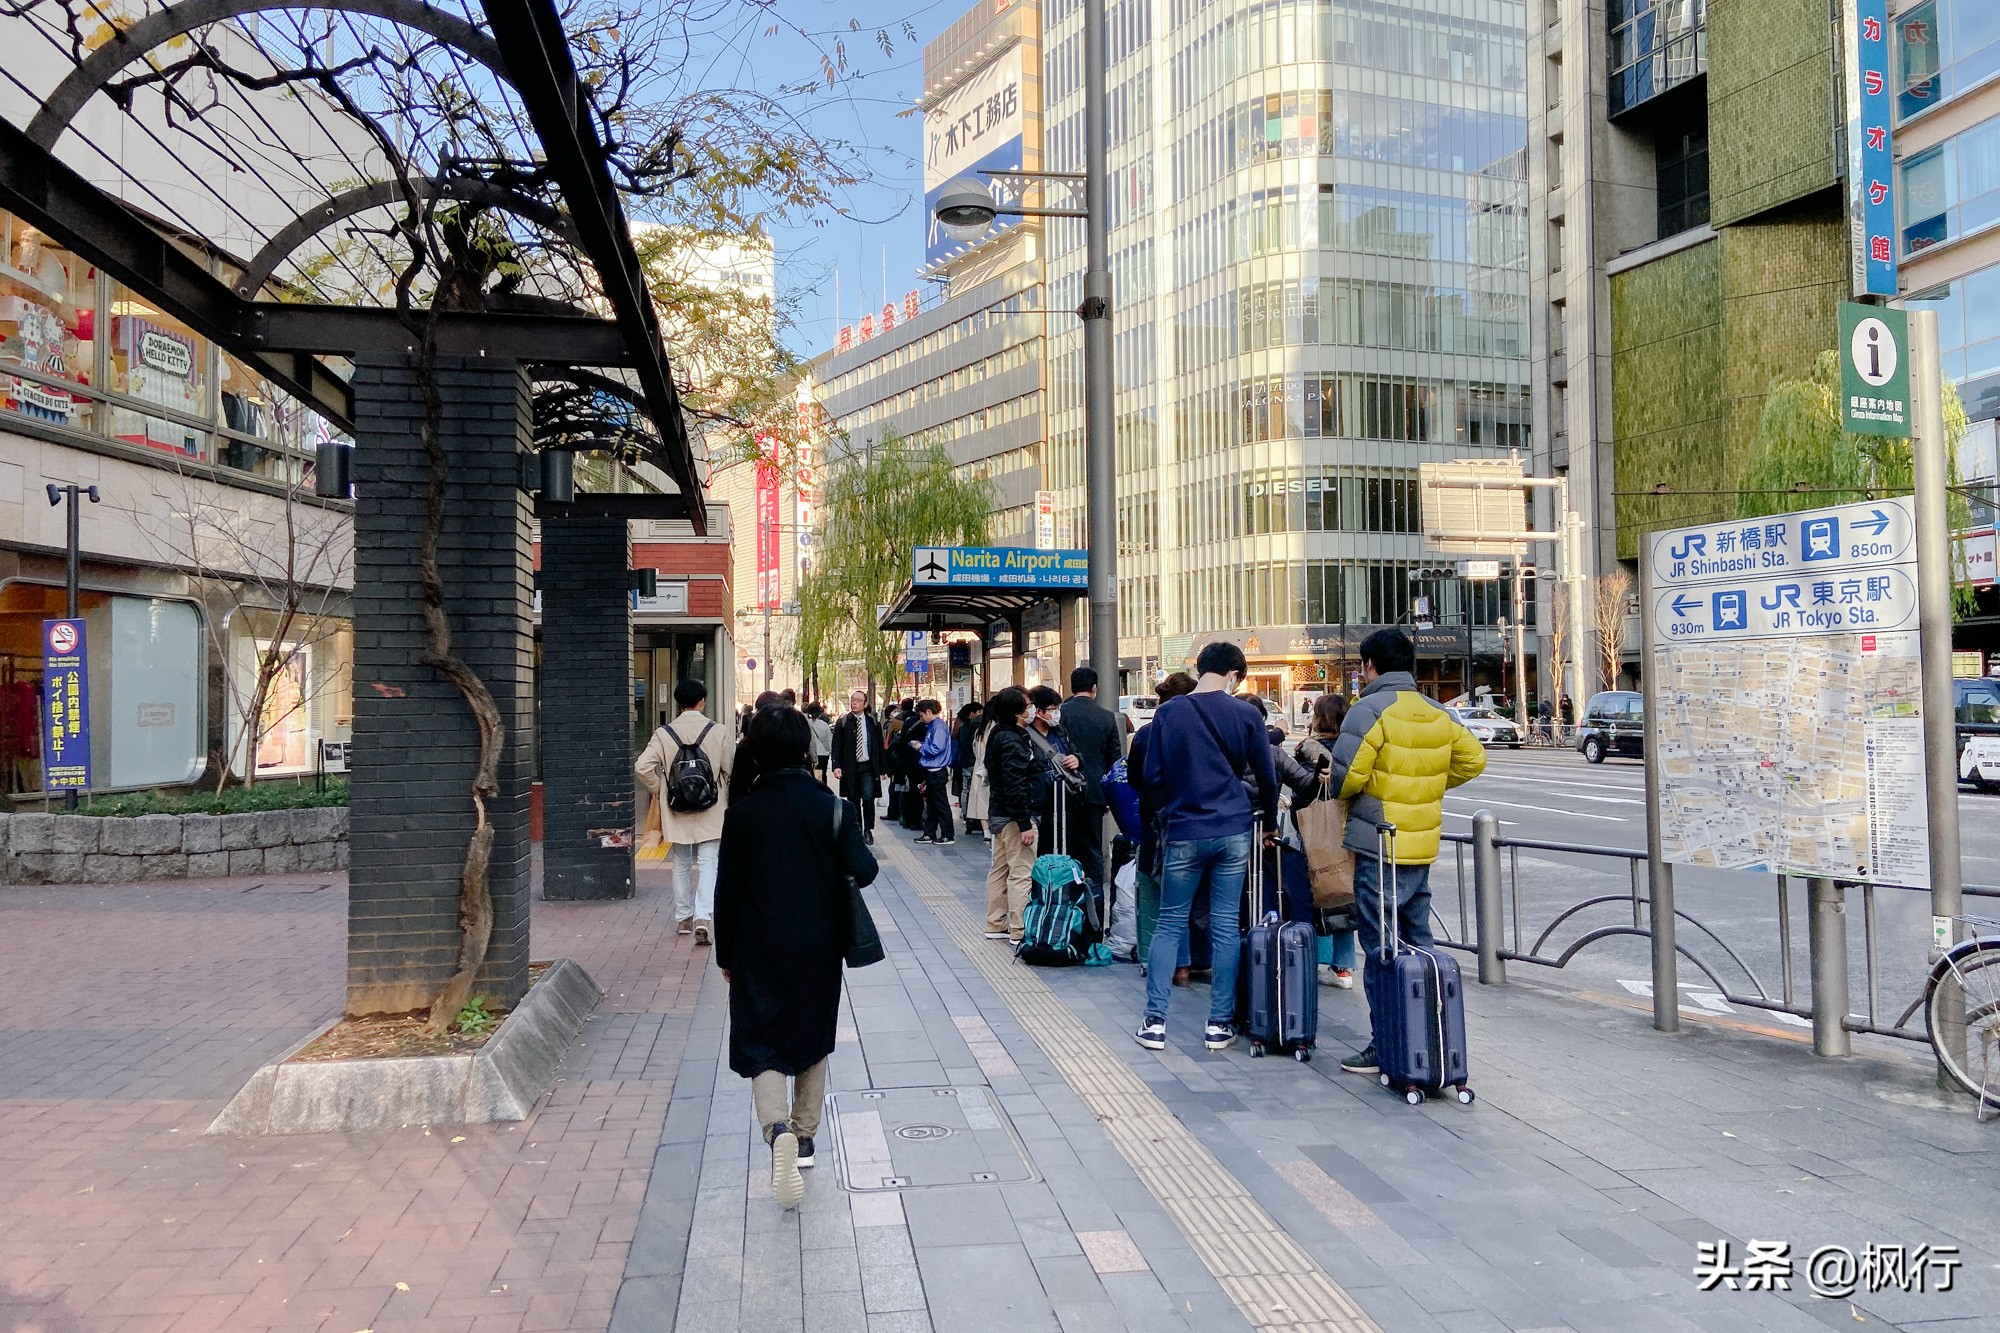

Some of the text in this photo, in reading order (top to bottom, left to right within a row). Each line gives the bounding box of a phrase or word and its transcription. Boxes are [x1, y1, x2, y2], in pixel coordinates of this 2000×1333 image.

[945, 82, 1018, 159] 木下工務店
[1863, 16, 1891, 263] カラオケ館
[148, 337, 186, 358] DORAEMON
[145, 348, 188, 369] HELLO KITTY
[1256, 382, 1303, 394] SHISEDO
[1249, 478, 1337, 497] DIESEL
[1671, 523, 1788, 559] JR 新橋駅
[1851, 542, 1893, 558] 850m
[952, 550, 1061, 573] Narita Airport
[1670, 550, 1790, 578] JR Shinbashi Sta.
[1760, 575, 1893, 611] JR 東京駅
[1671, 622, 1705, 635] 930m
[1772, 606, 1880, 630] JR Tokyo Sta.
[1417, 635, 1457, 643] DYNASTY
[60, 777, 86, 786] 中央区
